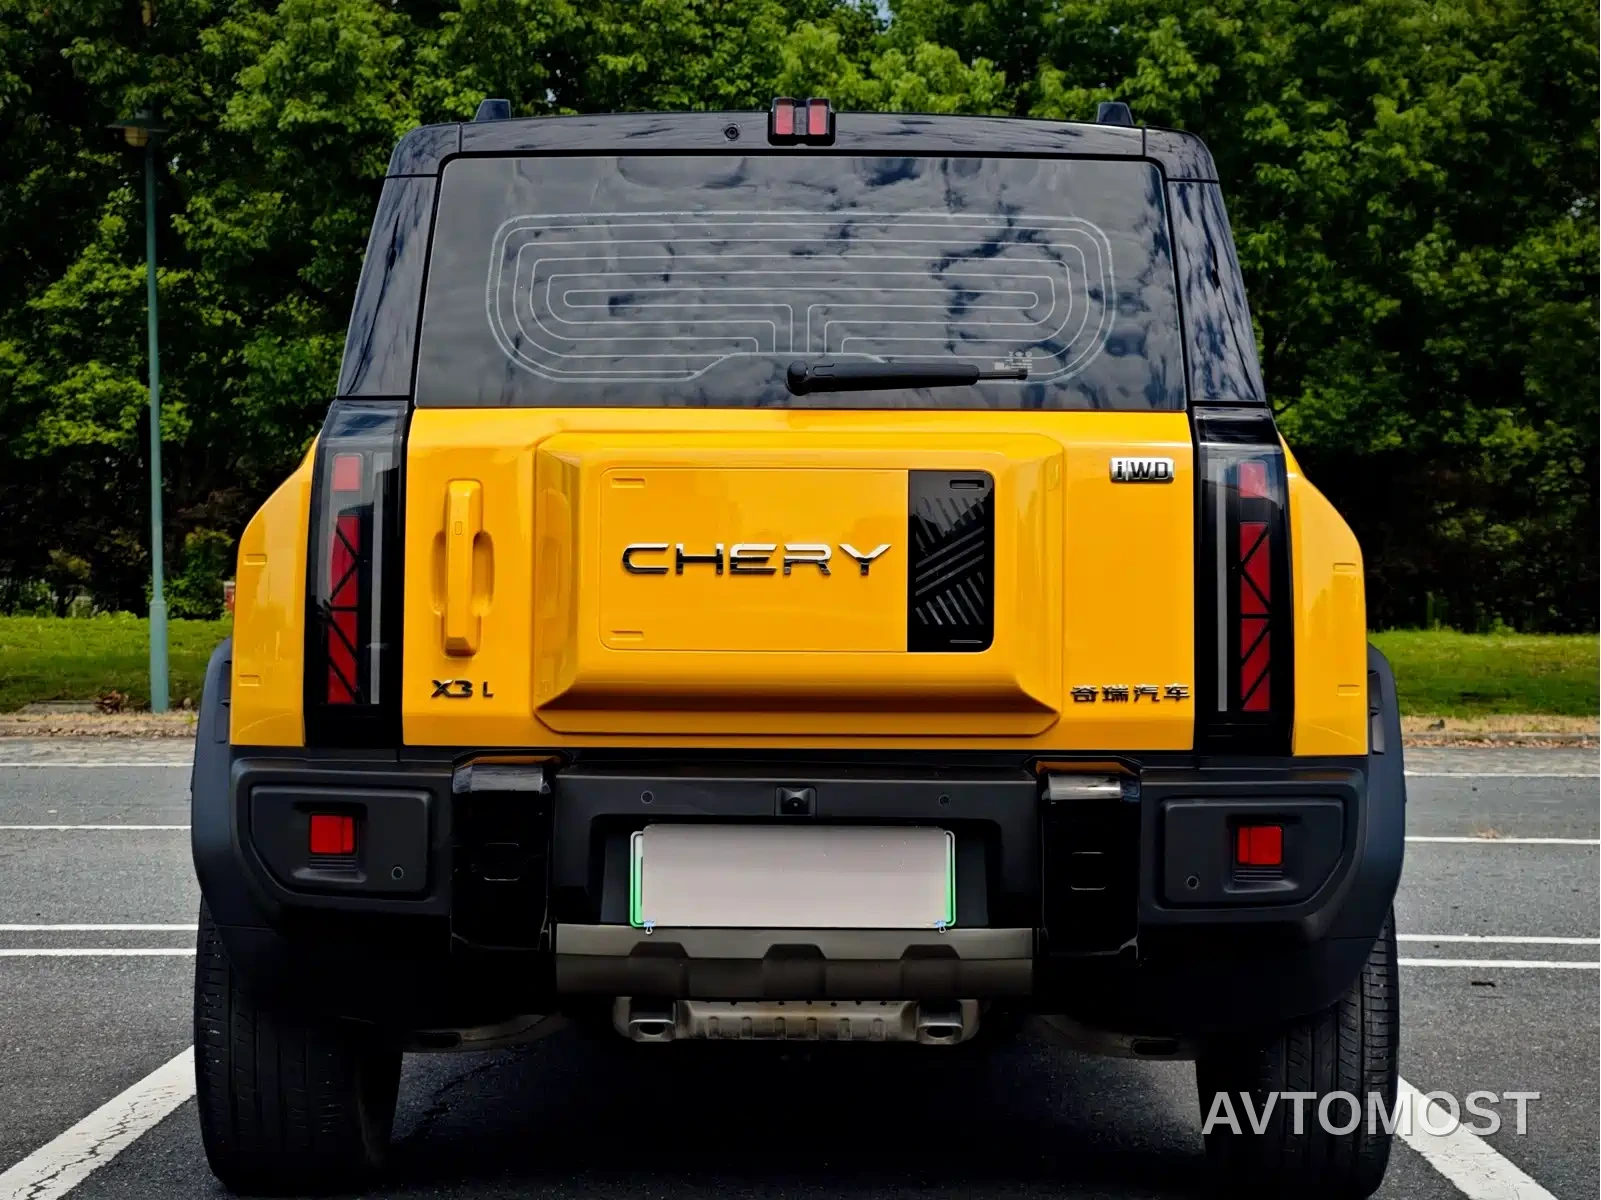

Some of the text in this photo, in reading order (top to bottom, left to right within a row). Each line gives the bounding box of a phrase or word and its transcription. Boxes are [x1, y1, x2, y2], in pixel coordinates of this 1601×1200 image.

[622, 543, 892, 576] CHERY
[431, 679, 494, 698] X3 L
[1070, 683, 1190, 703] 奇瑞汽车
